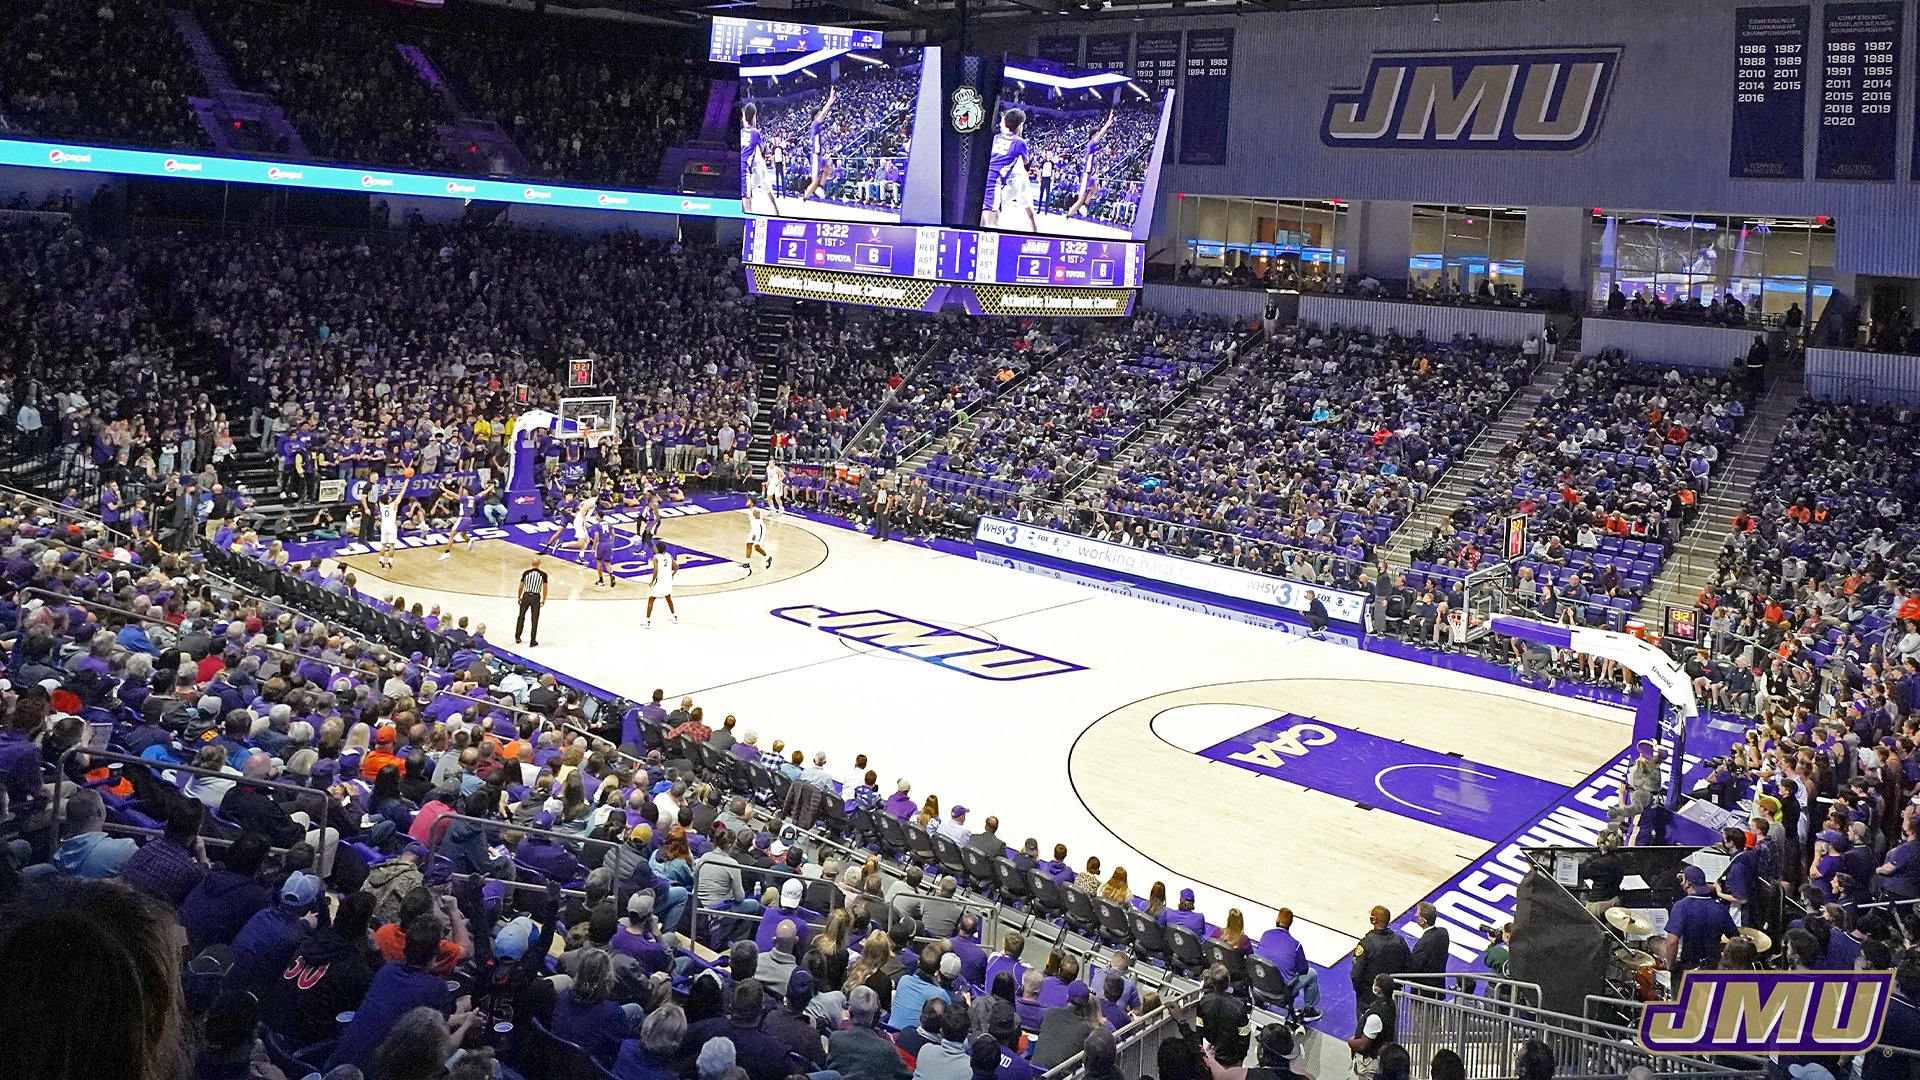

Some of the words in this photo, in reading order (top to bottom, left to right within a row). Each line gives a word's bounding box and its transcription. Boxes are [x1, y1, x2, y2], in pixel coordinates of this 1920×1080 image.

[767, 23, 801, 36] 13:22
[1739, 45, 1766, 54] 1986
[1774, 44, 1802, 53] 1987
[1827, 42, 1856, 51] 1986
[1864, 41, 1893, 51] 1987
[1188, 59, 1204, 67] 1981
[1210, 58, 1228, 66] 1983
[1738, 57, 1766, 66] 1988
[1774, 57, 1802, 66] 1989
[1826, 54, 1856, 64] 1988
[1863, 54, 1893, 63] 1989
[1209, 68, 1227, 76] 2013
[1738, 69, 1766, 78] 2010
[1773, 69, 1799, 78] 2011
[1826, 67, 1852, 76] 1991
[1863, 66, 1893, 76] 1995
[1738, 81, 1765, 90] 2014
[1773, 81, 1801, 90] 2015
[1825, 79, 1851, 88] 2011
[1862, 79, 1892, 89] 2014
[1738, 93, 1765, 102] 2016
[1825, 92, 1854, 101] 2015
[1862, 91, 1892, 101] 2016
[1325, 57, 1611, 146] JMU
[1824, 104, 1853, 113] 2018
[1861, 104, 1891, 114] 2019
[1823, 117, 1856, 126] 2020
[63, 153, 91, 163] pepsi
[176, 162, 203, 172] pepsi
[816, 223, 849, 238] 13:22
[788, 243, 797, 257] 2
[1060, 241, 1088, 254] 13:22
[826, 253, 851, 263] TOYOTA
[868, 248, 879, 263] 6
[1029, 260, 1040, 275] 2
[1099, 263, 1107, 277] 6
[577, 372, 588, 384] 14
[384, 510, 389, 518] 0
[983, 522, 1009, 537] WHSV
[1005, 525, 1019, 544] 3
[1037, 534, 1050, 543] FOX
[663, 559, 668, 567] 2
[1078, 545, 1136, 572] working
[1139, 556, 1175, 576] hard
[1246, 580, 1279, 595] WHSV
[1275, 583, 1293, 605] 3
[1317, 593, 1332, 604] FOX
[1672, 610, 1695, 622] 13:21
[1677, 622, 1691, 635] 14
[770, 605, 1091, 681] JMU
[1650, 665, 1674, 689] SPALDING
[1226, 723, 1338, 769] CAA
